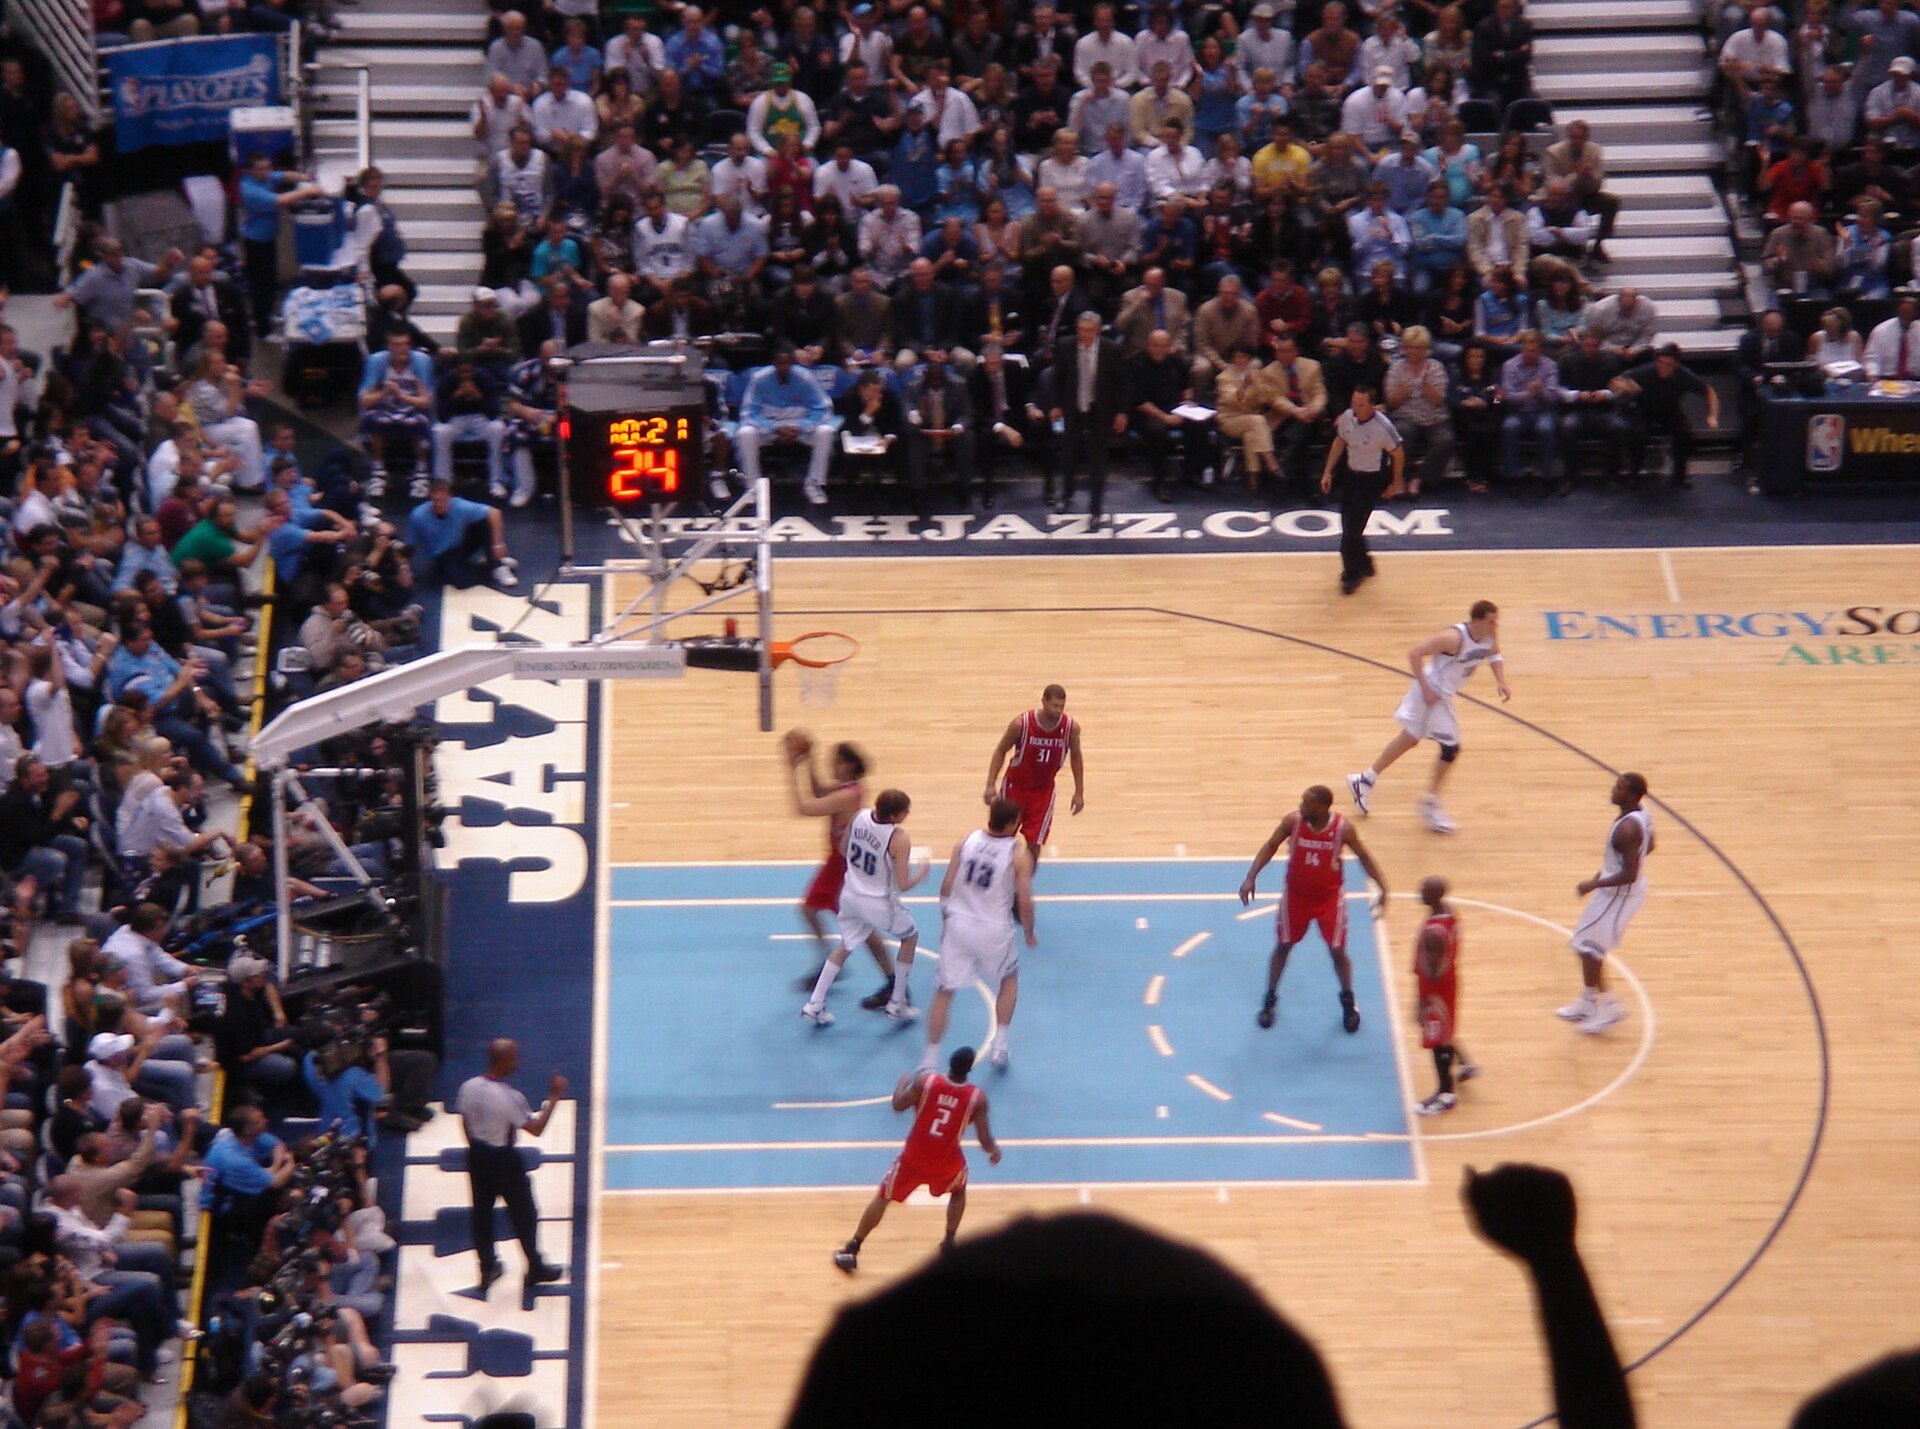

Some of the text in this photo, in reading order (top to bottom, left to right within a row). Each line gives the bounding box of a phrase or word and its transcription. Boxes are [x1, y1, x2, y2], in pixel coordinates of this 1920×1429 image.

[610, 417, 688, 445] 10:21
[610, 448, 678, 498] 24
[606, 508, 1454, 544] UTAHJAZZ.COM
[1776, 643, 1919, 666] ARE
[434, 581, 590, 903] JAZZ
[1029, 735, 1066, 748] ROCKETS
[1037, 748, 1051, 763] 31
[849, 842, 877, 876] 26
[928, 1107, 952, 1137] 2
